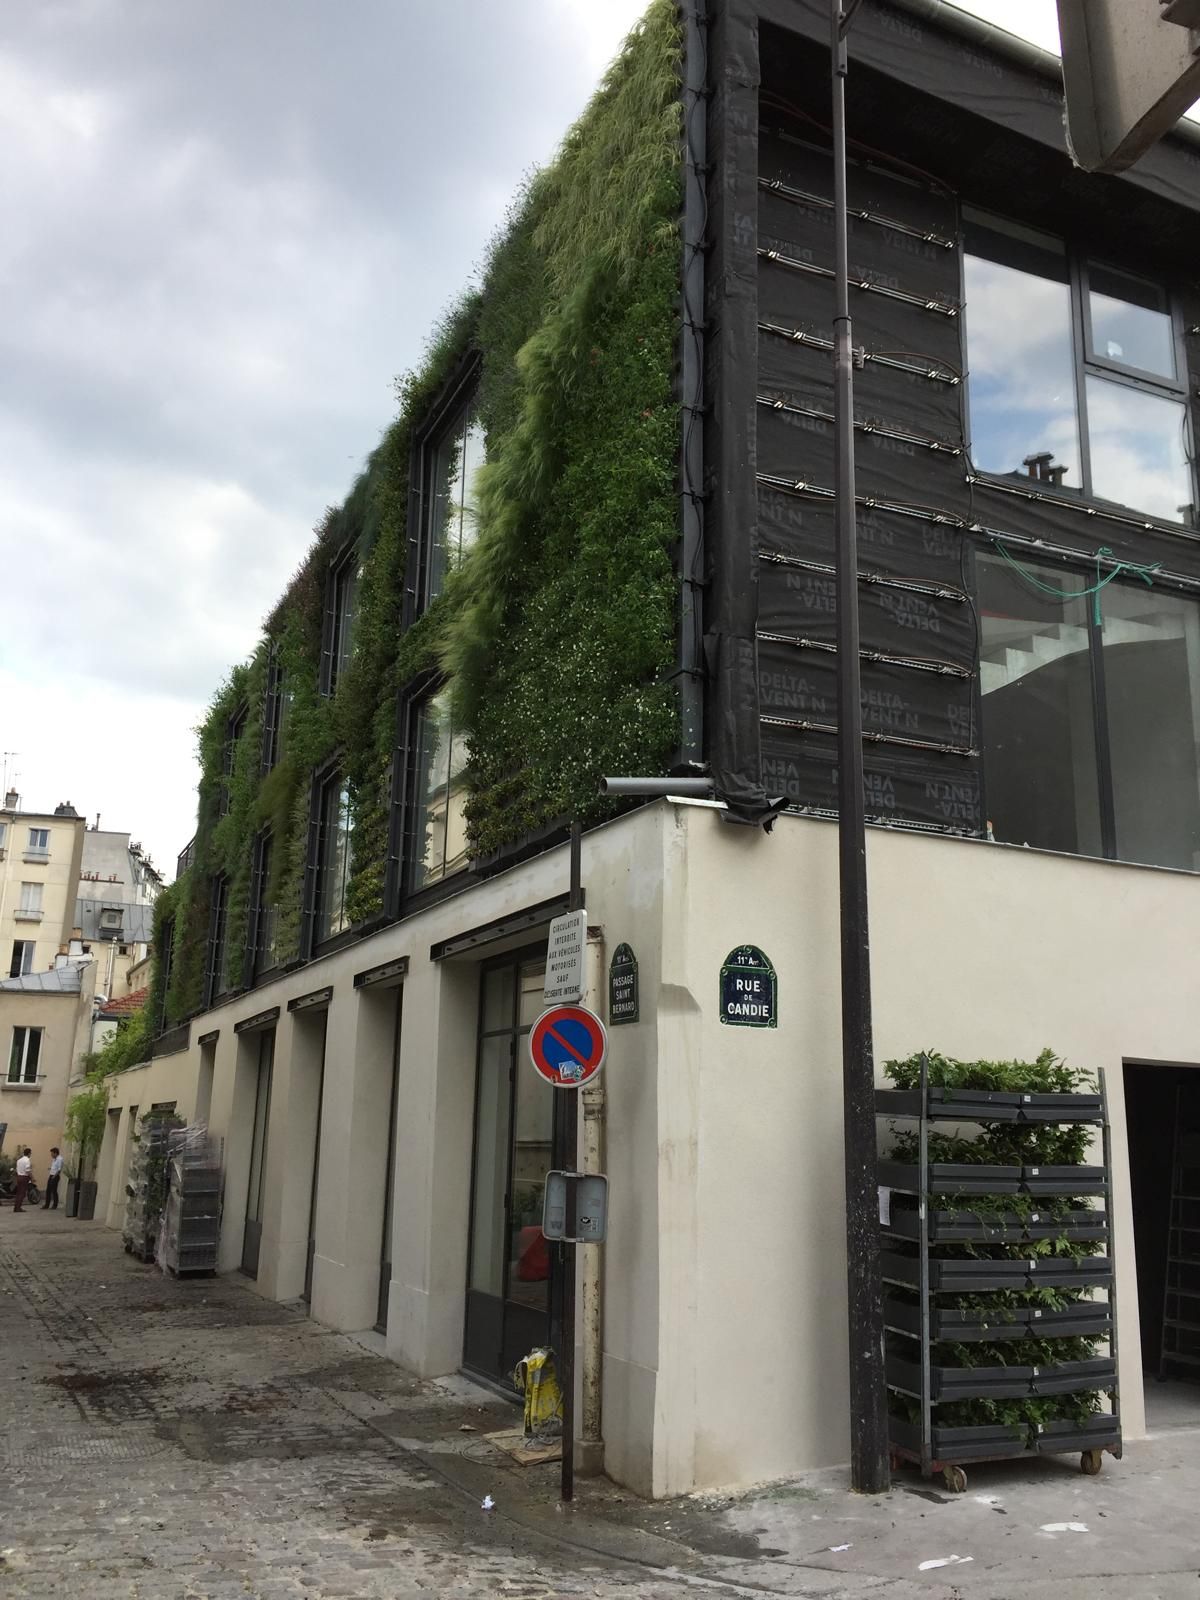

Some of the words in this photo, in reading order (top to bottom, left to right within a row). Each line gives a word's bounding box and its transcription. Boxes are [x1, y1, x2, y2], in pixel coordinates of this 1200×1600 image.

[761, 687, 807, 709] VENT
[811, 696, 826, 713] N
[552, 918, 580, 934] CIRCULATION
[554, 932, 577, 945] INTERDITE
[548, 951, 558, 960] AUX
[556, 973, 569, 984] SAUF
[612, 974, 634, 988] PASSAGE
[736, 978, 761, 993] RUE
[616, 988, 631, 1001] SAINT
[743, 993, 753, 1002] DE
[612, 1001, 635, 1015] BERNARD
[727, 1002, 770, 1017] CANDIE
